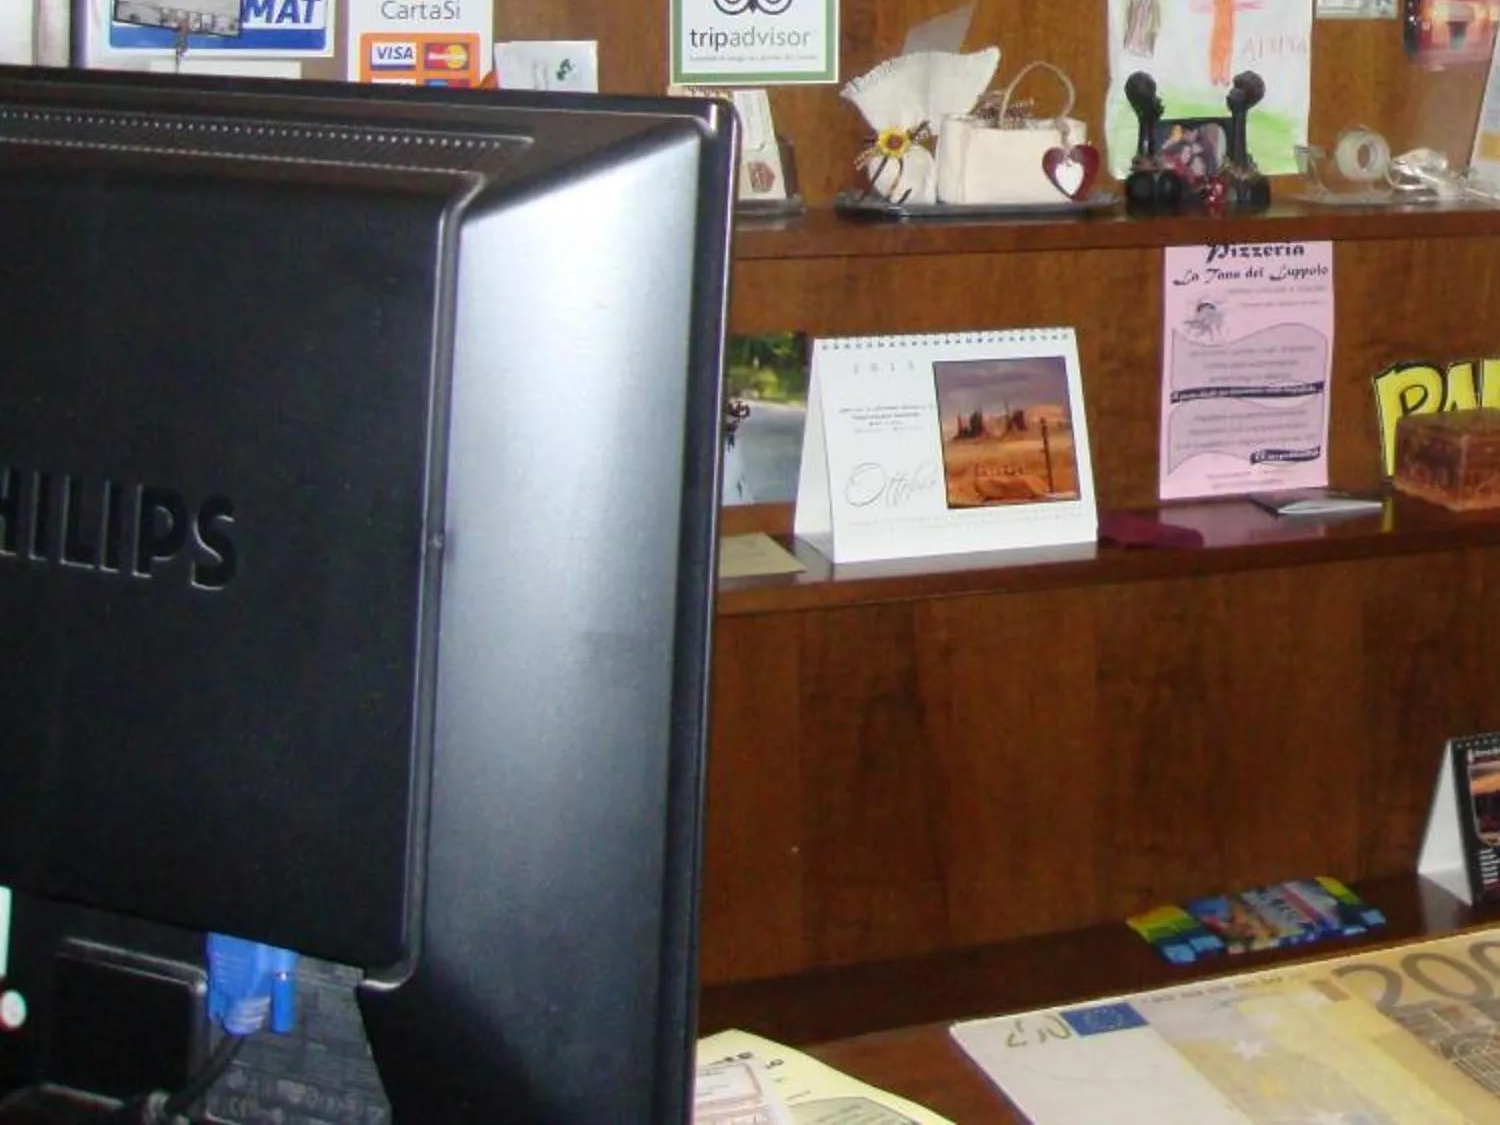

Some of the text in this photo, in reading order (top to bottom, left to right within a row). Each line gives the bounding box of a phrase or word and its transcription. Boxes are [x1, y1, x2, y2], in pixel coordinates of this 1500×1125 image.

[380, 0, 462, 21] CartaSi
[689, 26, 812, 52] tripadvisor
[376, 45, 414, 61] VISA
[1205, 243, 1305, 264] Pizzeria
